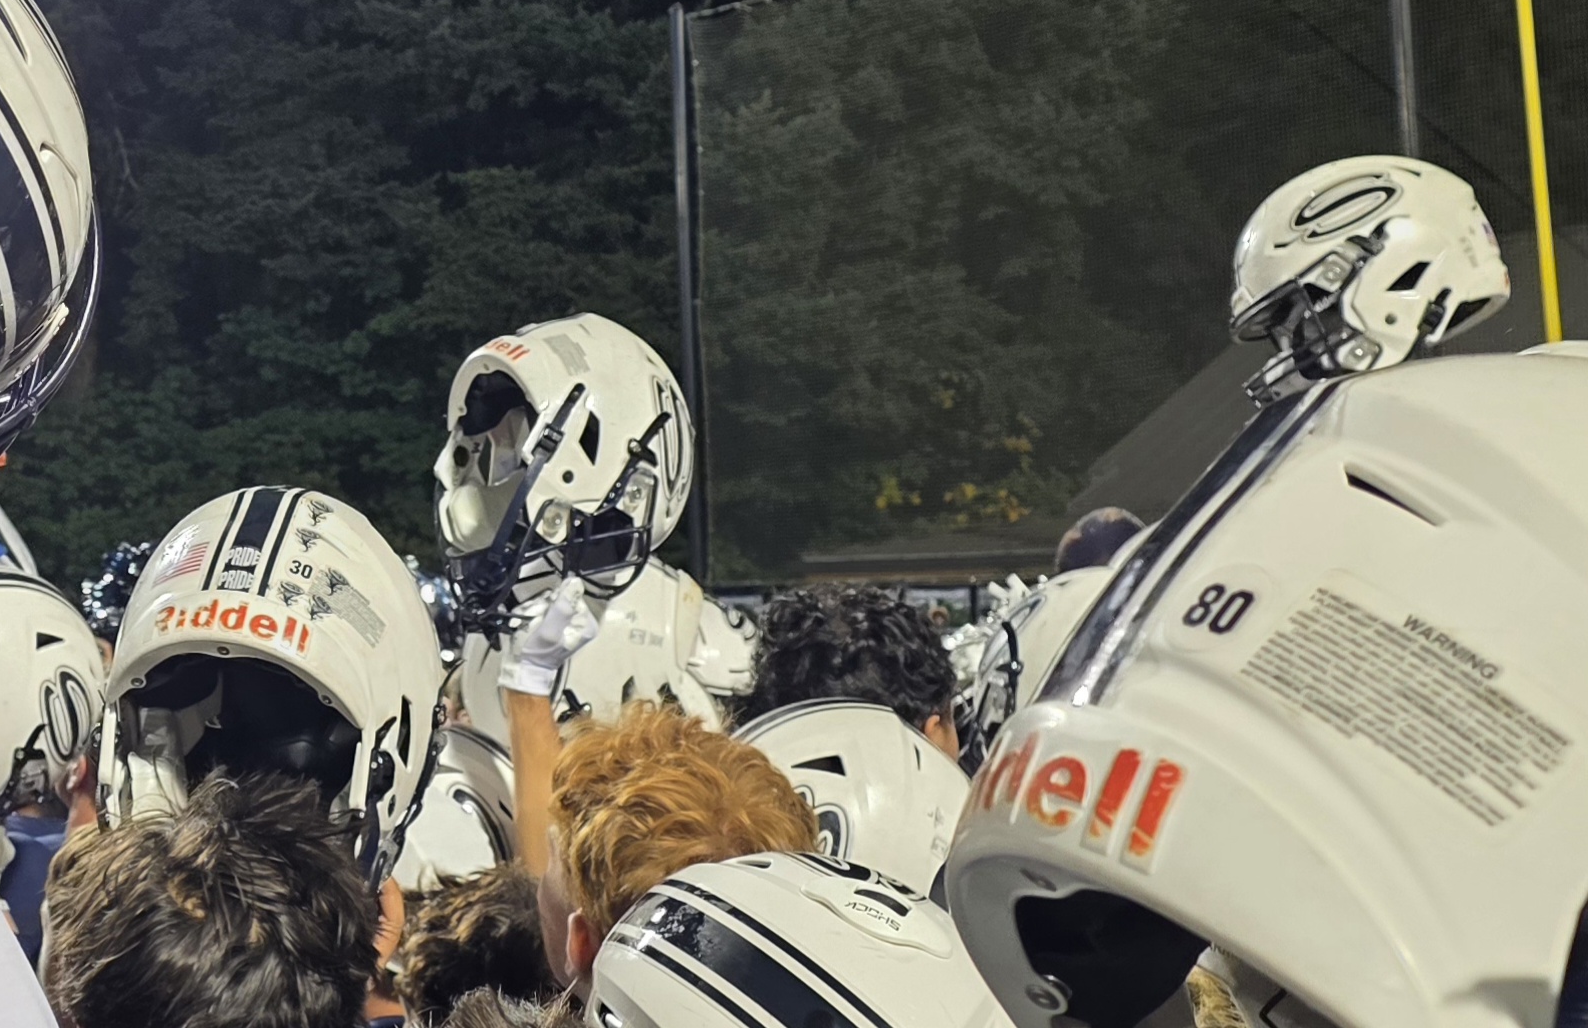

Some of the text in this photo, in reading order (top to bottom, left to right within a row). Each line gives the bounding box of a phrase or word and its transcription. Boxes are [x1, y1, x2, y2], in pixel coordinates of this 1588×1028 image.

[227, 546, 262, 567] PRIDE
[219, 569, 254, 590] PRIDE
[288, 559, 314, 580] 30
[1181, 583, 1255, 635] 80
[1402, 613, 1501, 680] WARNING
[844, 902, 902, 931] SHOCK
